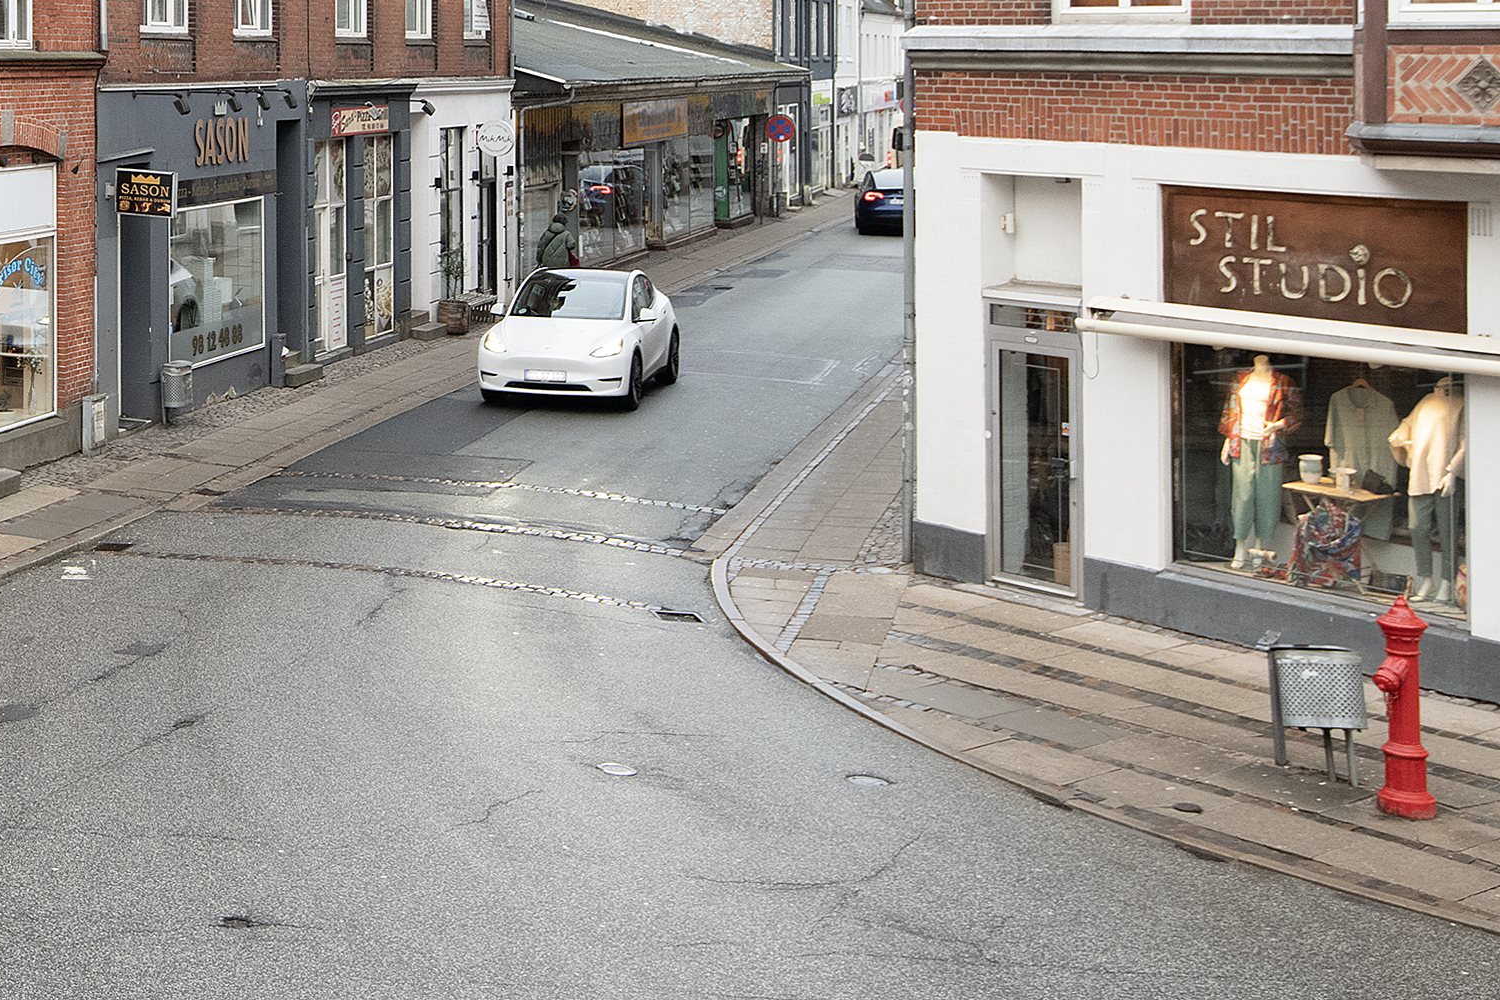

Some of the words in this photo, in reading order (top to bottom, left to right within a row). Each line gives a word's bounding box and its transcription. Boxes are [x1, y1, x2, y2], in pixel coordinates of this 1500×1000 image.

[195, 117, 249, 167] SASON
[121, 183, 170, 197] SASON
[1189, 208, 1287, 252] STIL
[24, 256, 43, 286] City
[192, 334, 204, 356] 98
[206, 330, 217, 352] 12
